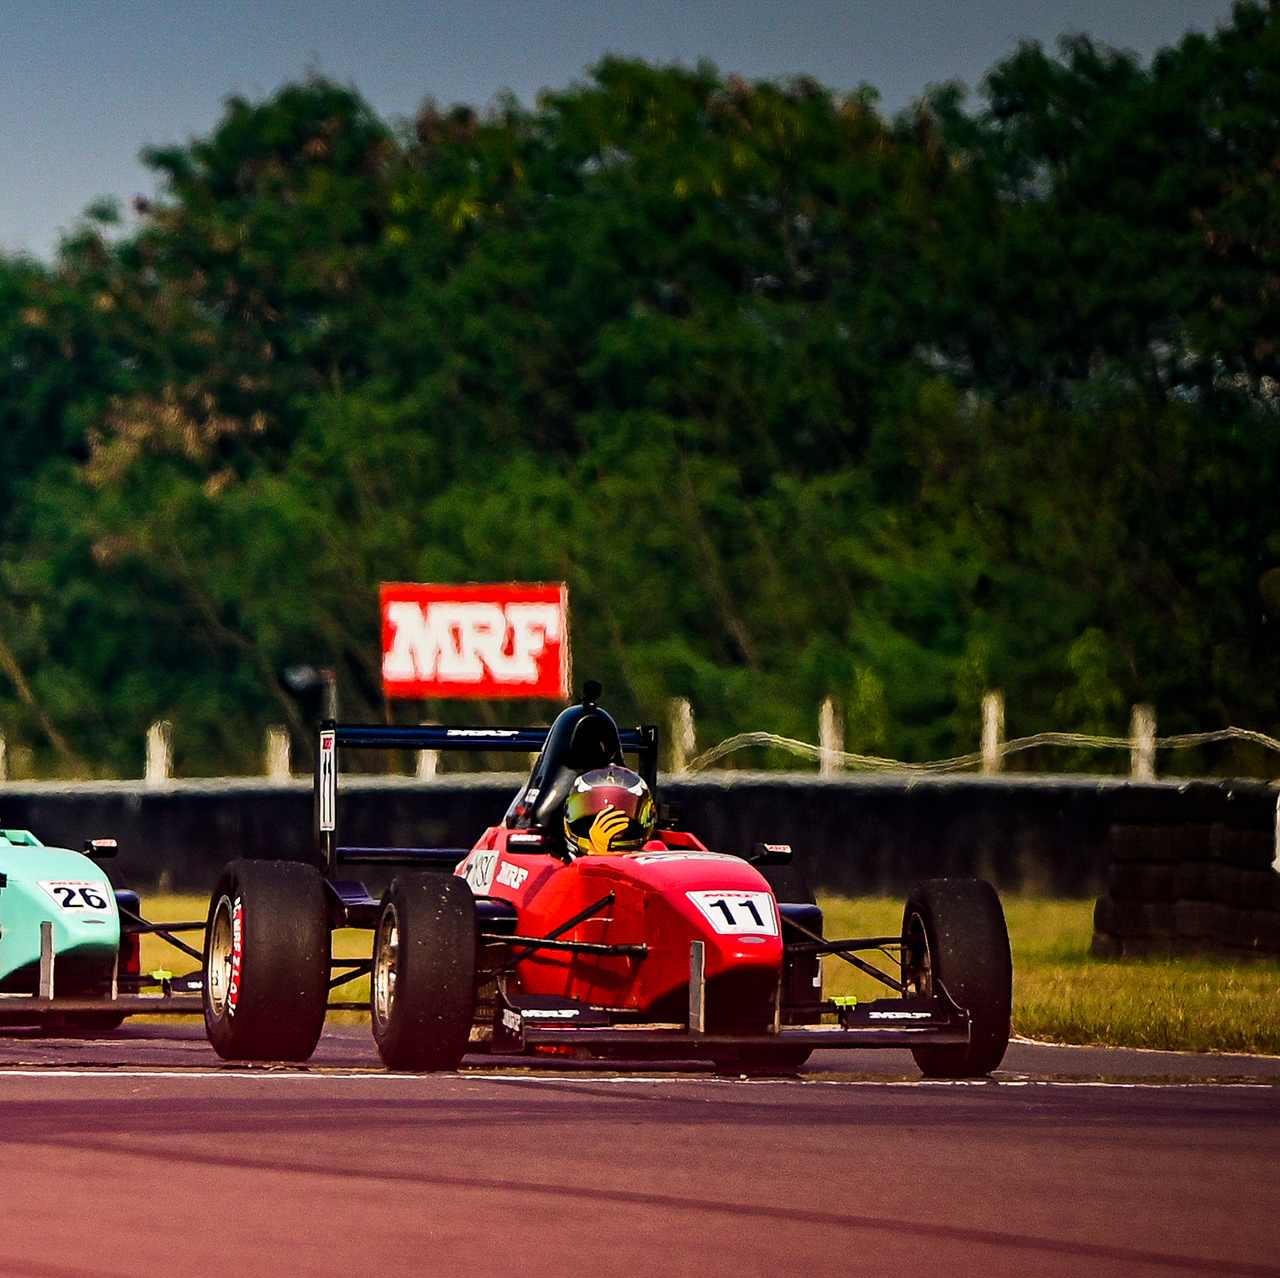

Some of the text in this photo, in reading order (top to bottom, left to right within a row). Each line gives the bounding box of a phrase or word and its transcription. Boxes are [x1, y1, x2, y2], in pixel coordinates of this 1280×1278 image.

[383, 601, 560, 685] MRF
[496, 861, 529, 890] MRF
[53, 887, 107, 909] 26
[709, 899, 765, 927] 11
